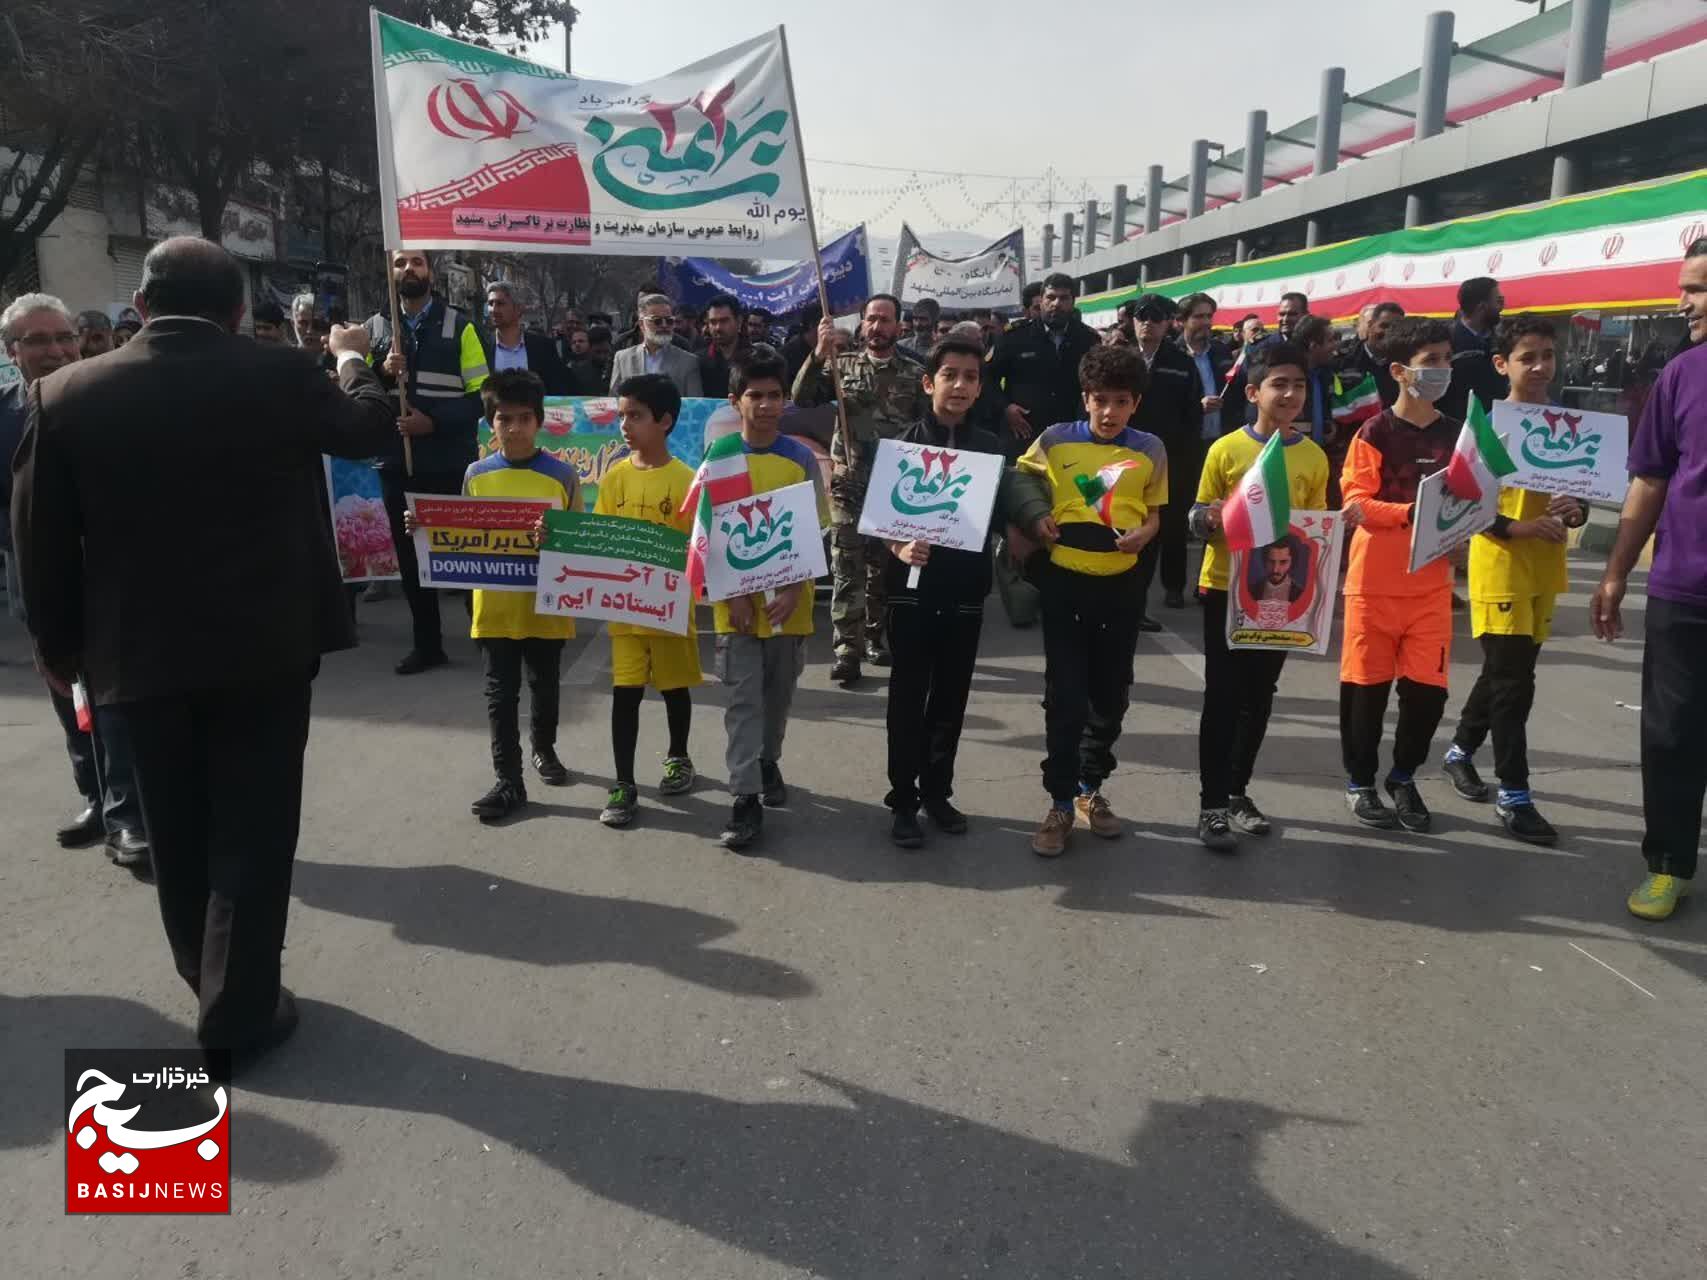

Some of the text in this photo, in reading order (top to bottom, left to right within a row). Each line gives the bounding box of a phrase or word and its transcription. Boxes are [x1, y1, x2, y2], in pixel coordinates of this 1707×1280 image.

[746, 196, 807, 225] یوم الله
[455, 212, 485, 227] مشهد
[544, 218, 554, 232] بر
[556, 216, 591, 234] نظارت
[603, 219, 645, 236] مدیریت
[593, 224, 600, 236] و
[647, 221, 685, 237] سازمان
[728, 222, 760, 240] روابط
[432, 528, 489, 551] آمریکا
[492, 537, 511, 553] بر
[432, 559, 481, 574] DOWN
[484, 561, 526, 576] WITH
[554, 563, 680, 592] تا آخر
[557, 586, 675, 622] ایستاده ایم
